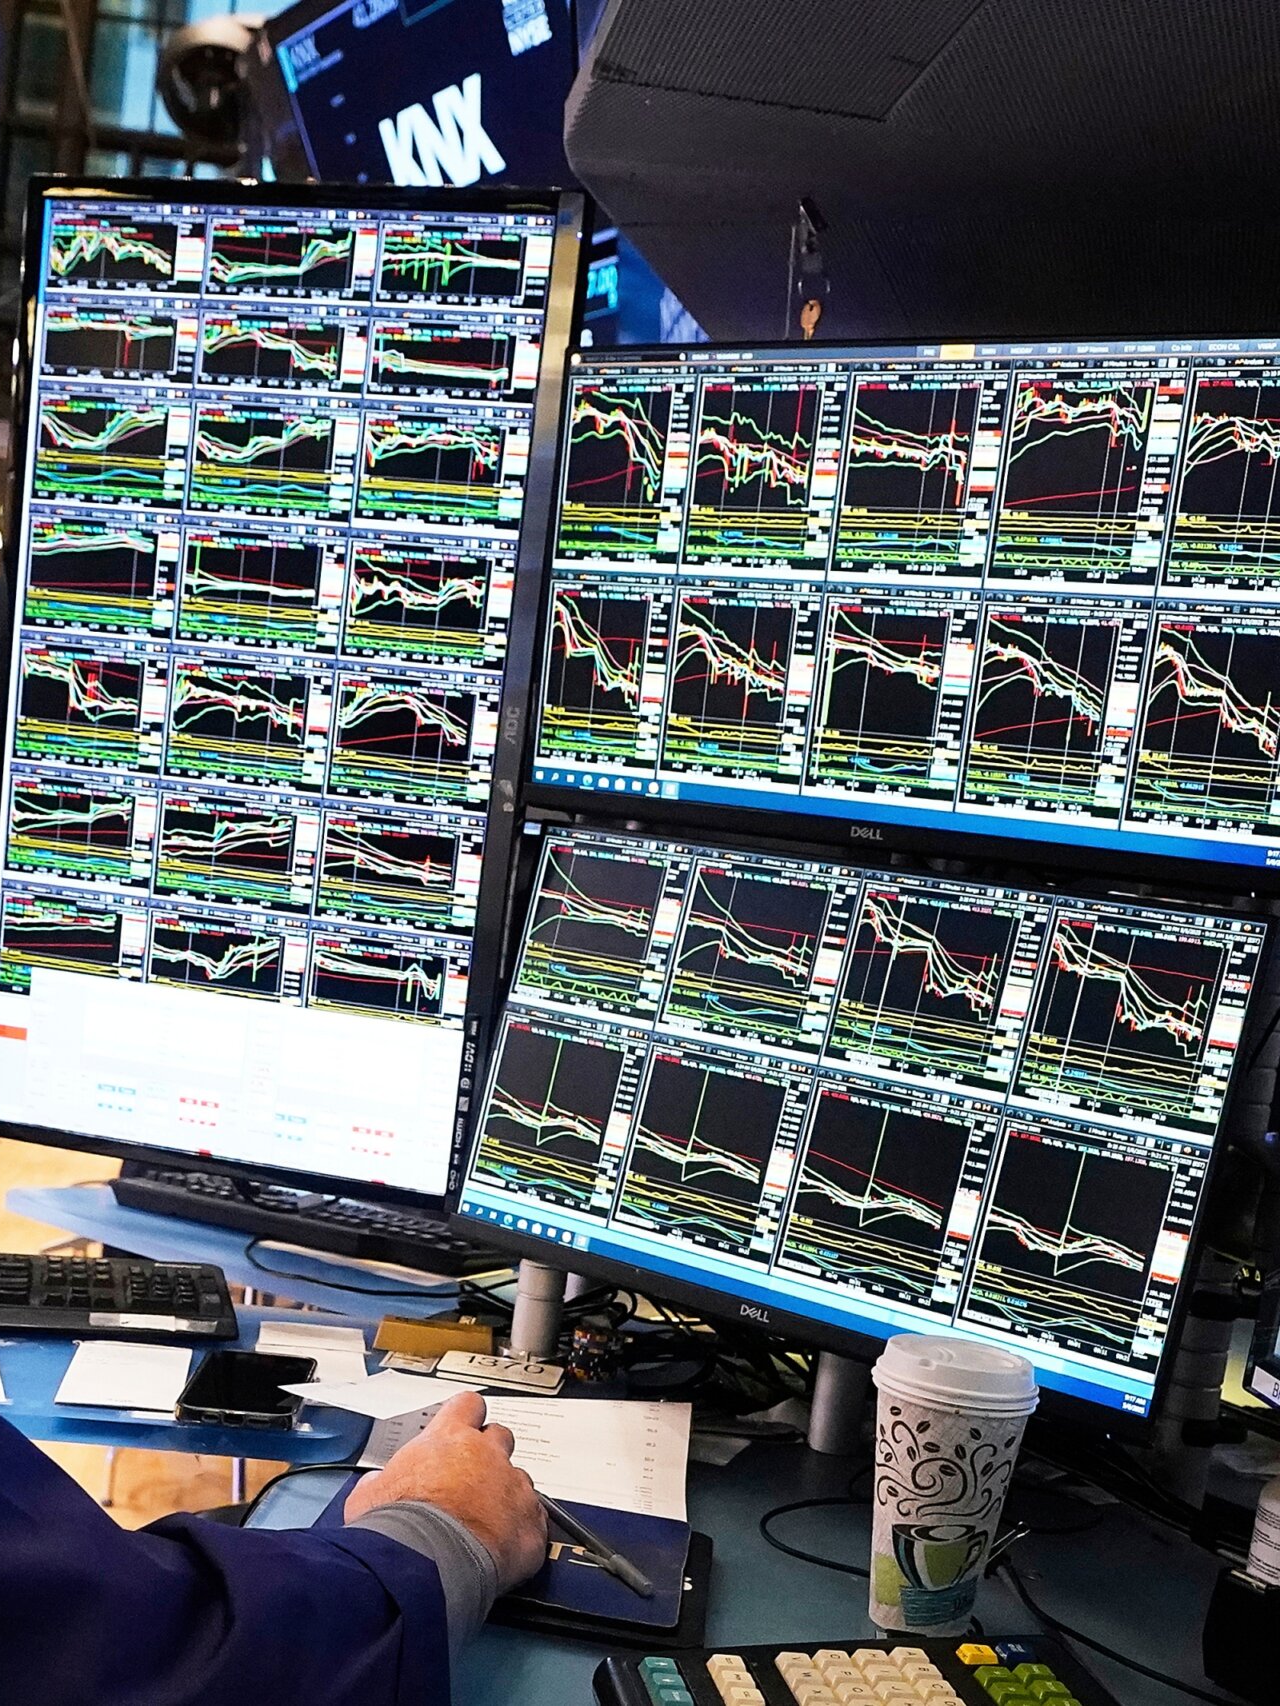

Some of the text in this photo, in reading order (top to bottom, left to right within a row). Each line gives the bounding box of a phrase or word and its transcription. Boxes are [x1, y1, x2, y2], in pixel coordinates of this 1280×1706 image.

[378, 72, 506, 187] KNX
[850, 826, 883, 840] DELL
[740, 1304, 770, 1323] DELL
[468, 1355, 544, 1374] 1370
